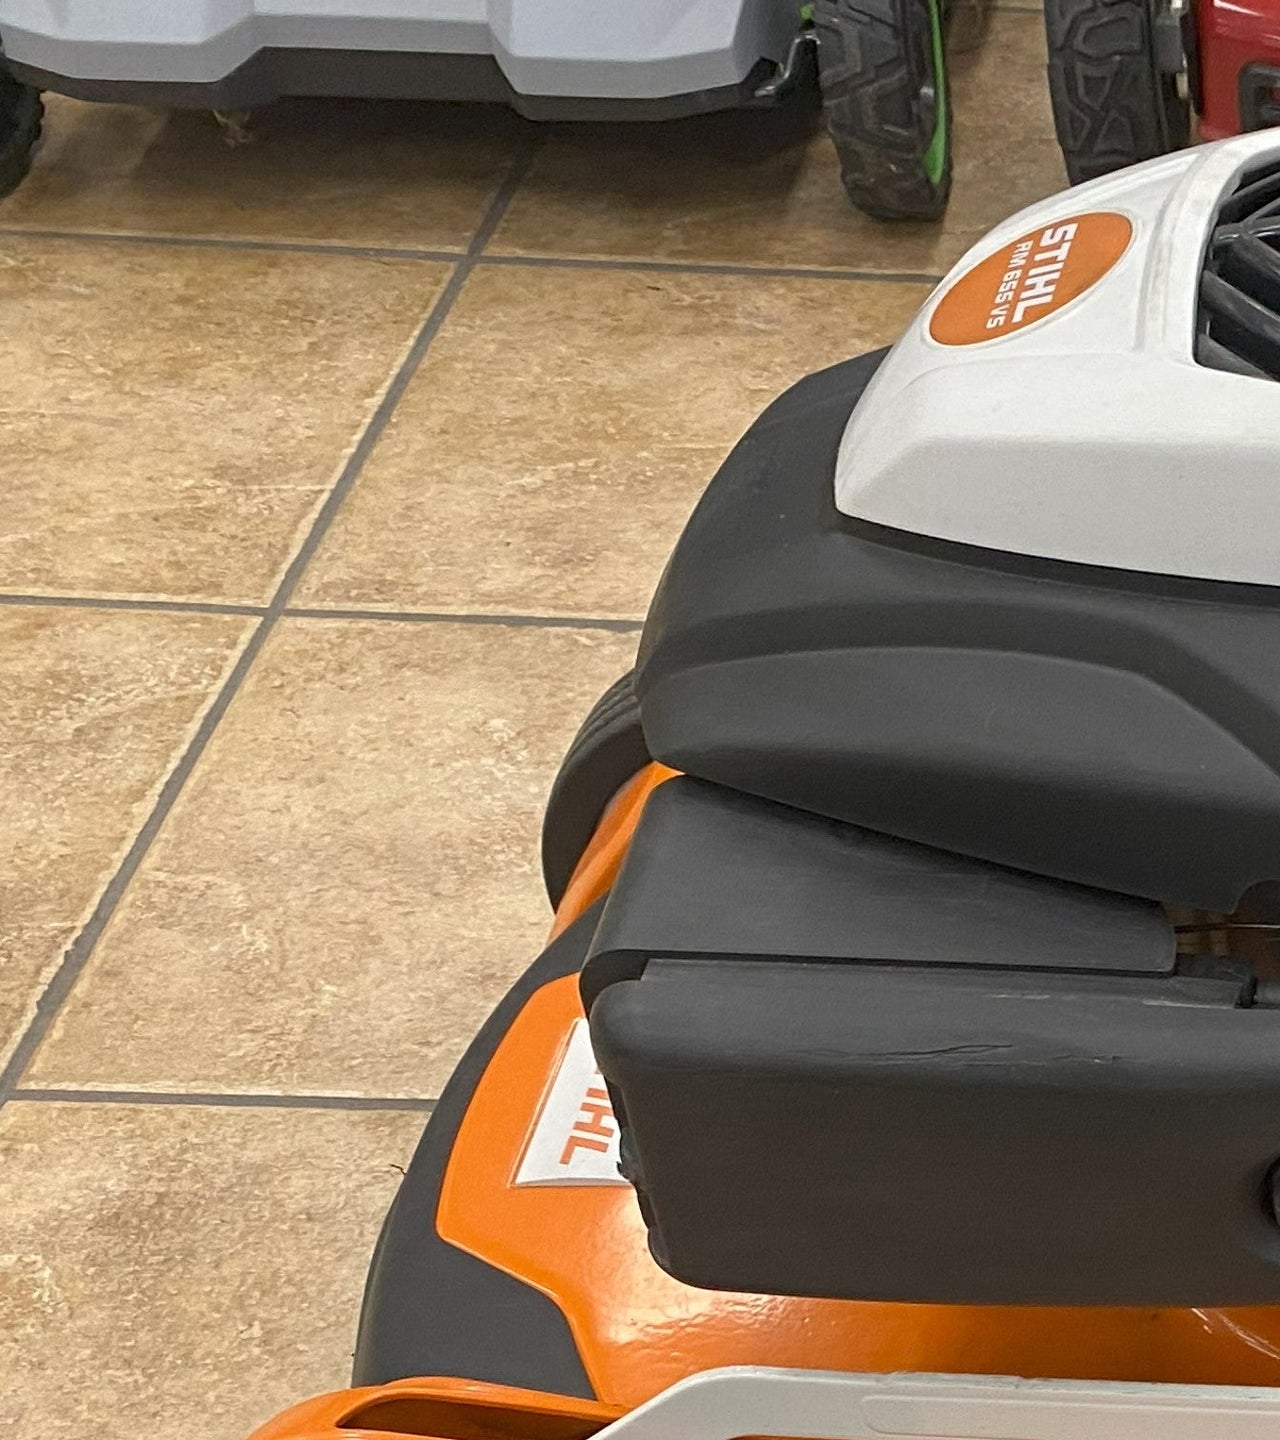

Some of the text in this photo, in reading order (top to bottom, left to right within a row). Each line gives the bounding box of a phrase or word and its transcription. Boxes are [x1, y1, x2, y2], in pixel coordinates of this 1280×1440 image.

[986, 240, 1033, 329] RM 655 VS
[1012, 223, 1078, 323] STIHL
[558, 1067, 615, 1165] IHL
